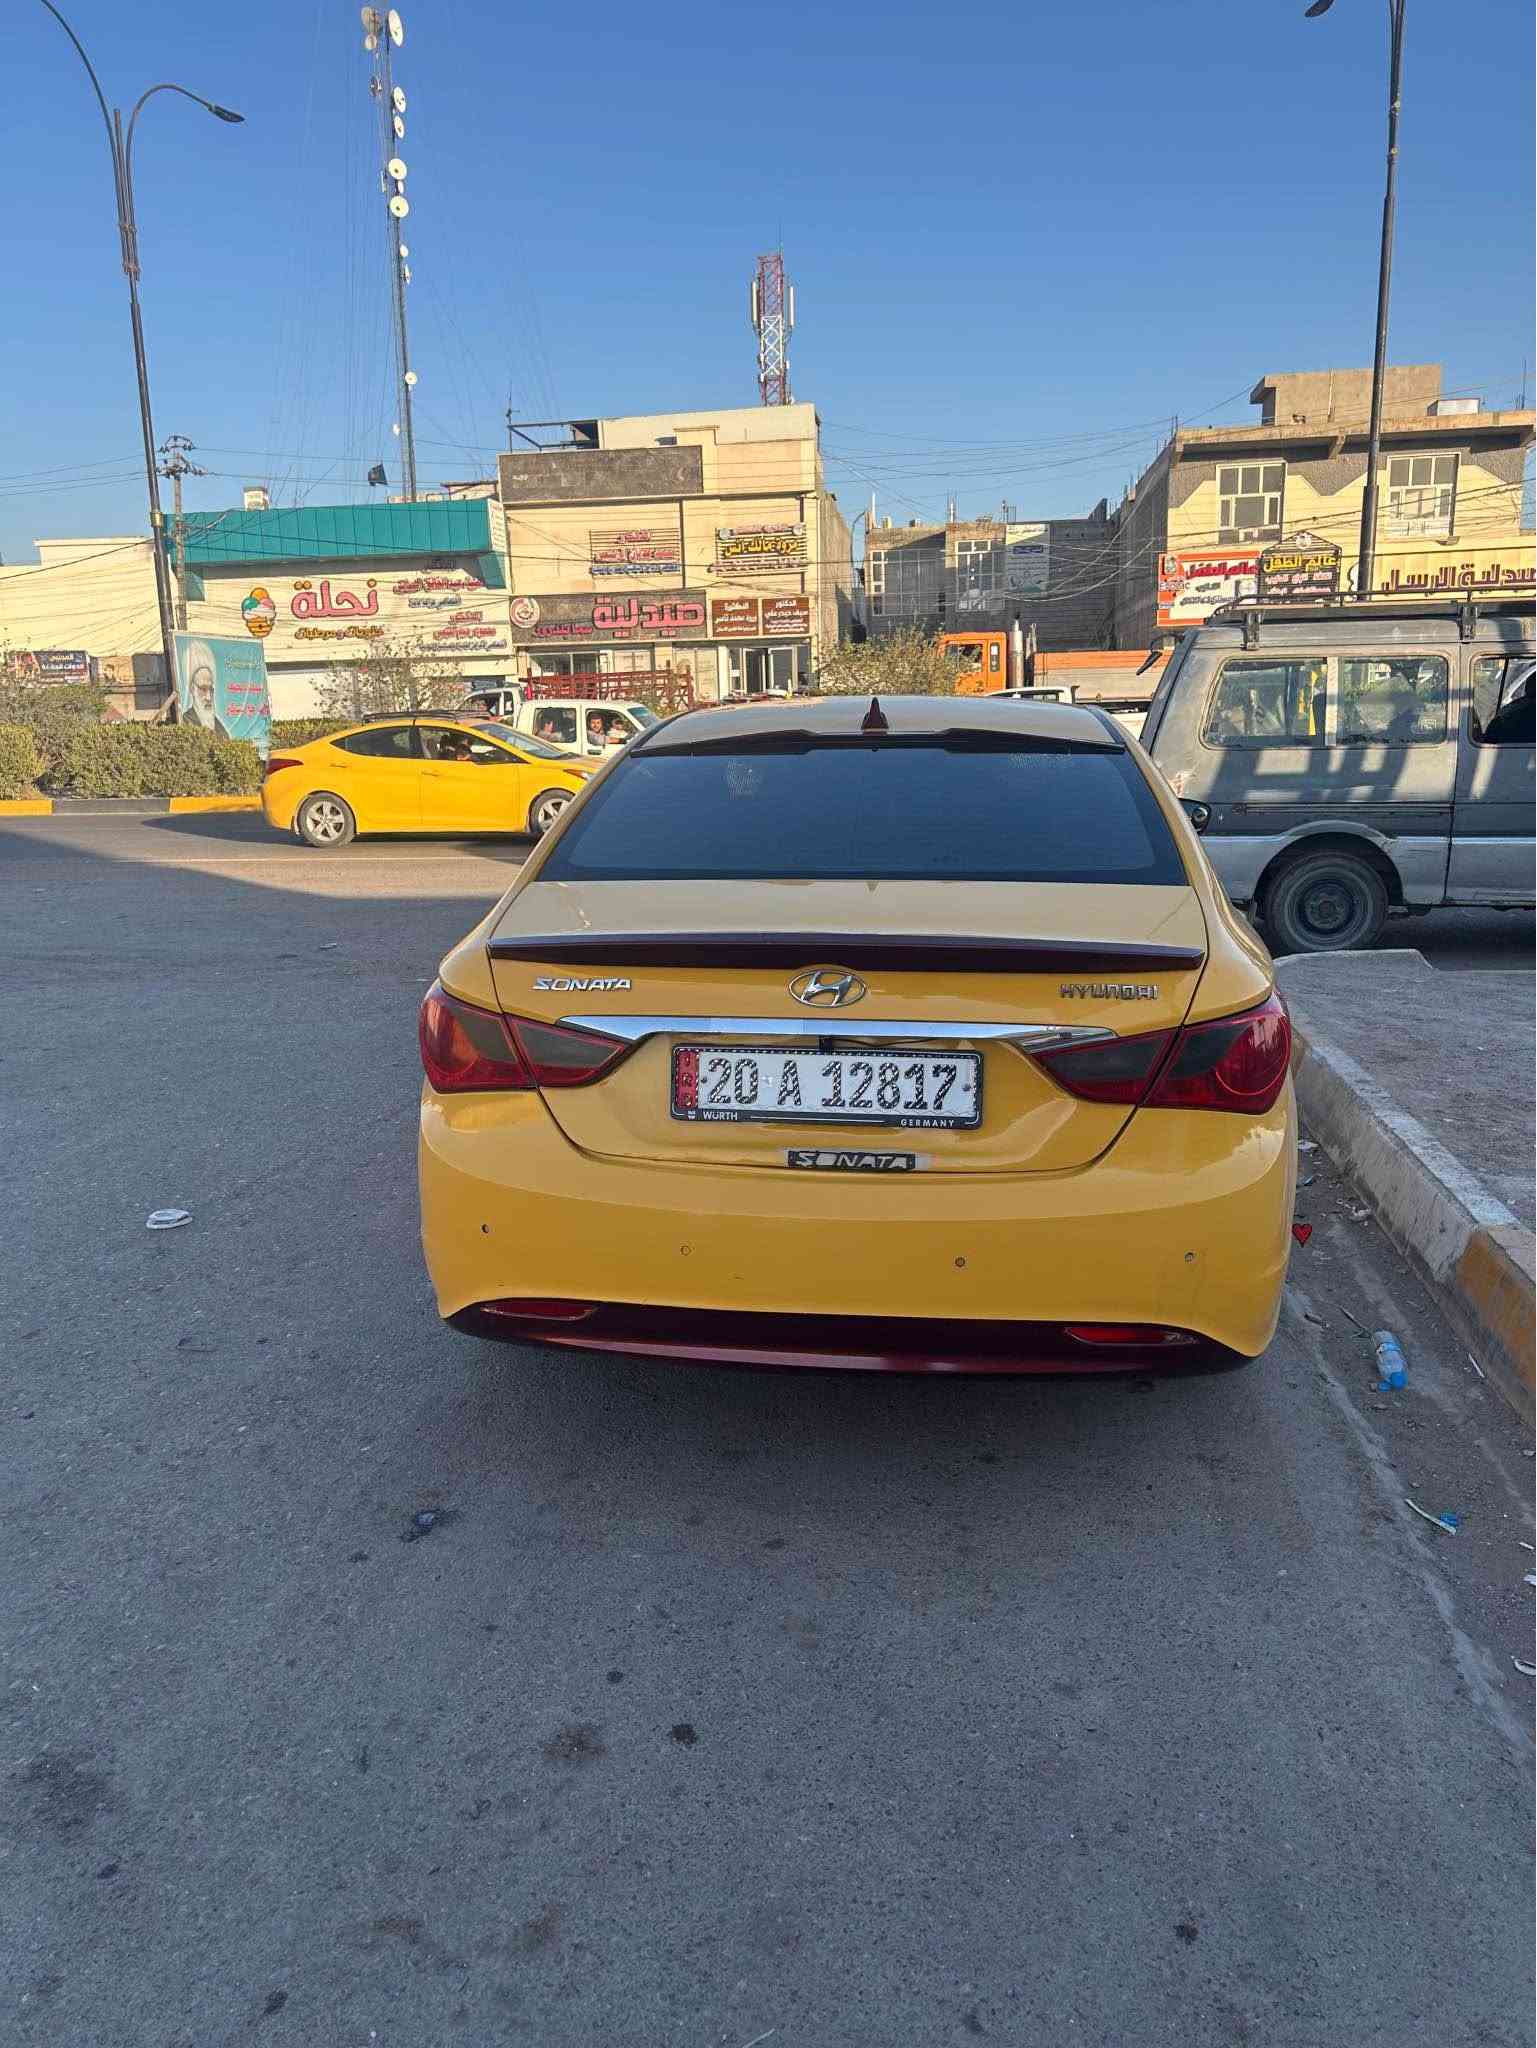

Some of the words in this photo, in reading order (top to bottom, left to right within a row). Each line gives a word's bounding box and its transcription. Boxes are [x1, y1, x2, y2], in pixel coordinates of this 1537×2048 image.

[1263, 553, 1302, 573] الطفل
[1306, 554, 1337, 573] عالم
[291, 578, 379, 619] نحلة
[592, 596, 705, 638] صيدلية
[532, 977, 632, 992] SONATA
[1058, 983, 1160, 1000] HYUNDAI
[707, 1057, 759, 1105] 20
[776, 1059, 802, 1106] A
[821, 1060, 957, 1111] 12817
[900, 1118, 955, 1128] GERMANY
[797, 1151, 908, 1170] SONATA
